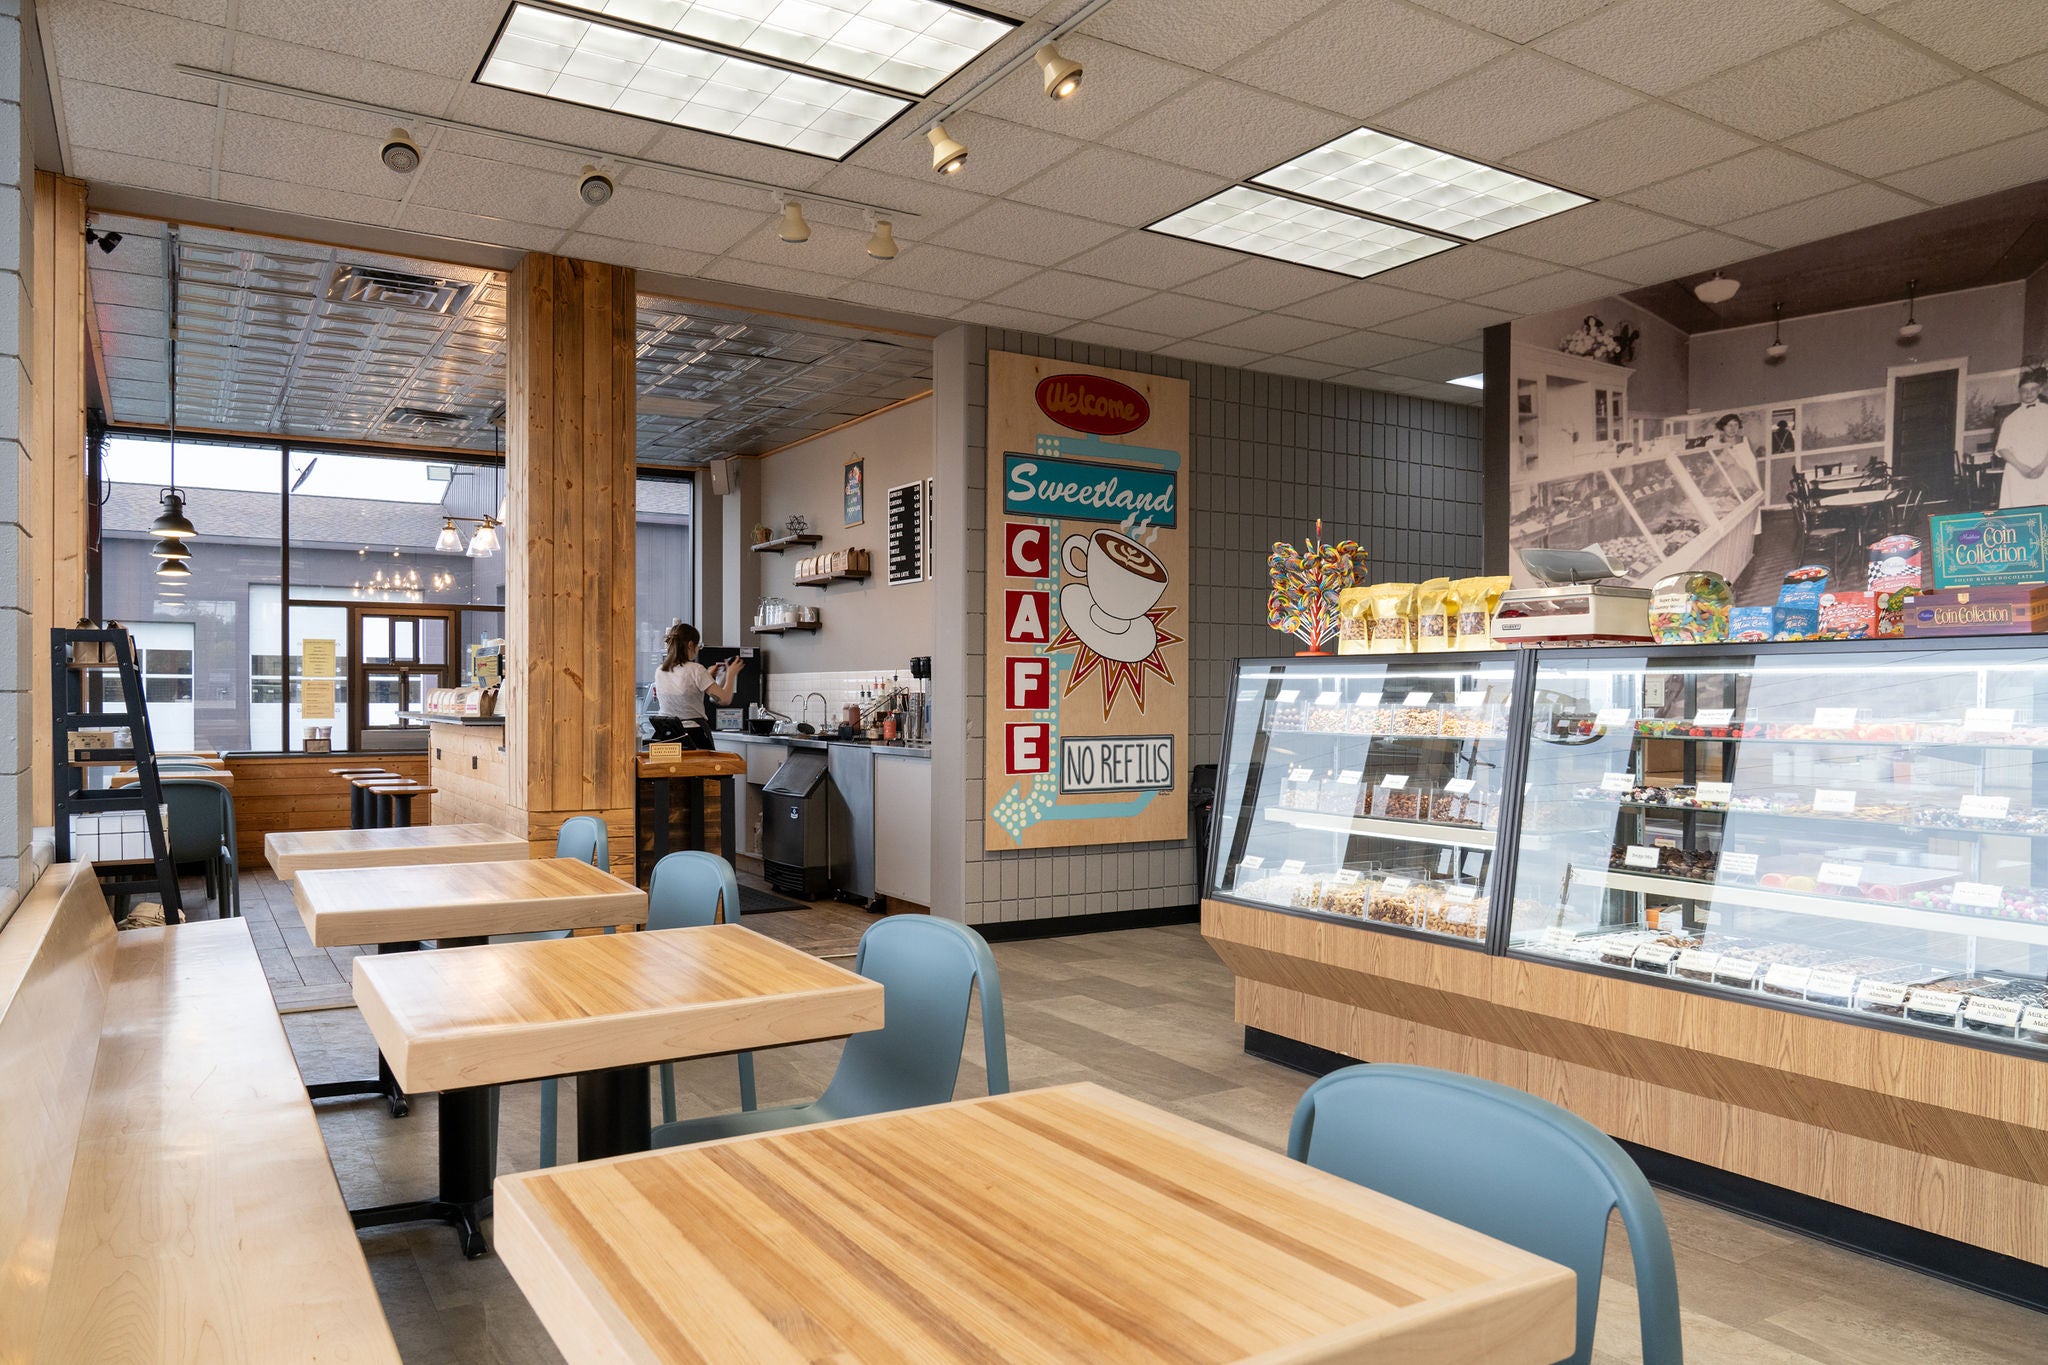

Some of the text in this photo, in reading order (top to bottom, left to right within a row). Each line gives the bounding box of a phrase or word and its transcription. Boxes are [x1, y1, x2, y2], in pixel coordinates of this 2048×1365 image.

[1046, 383, 1140, 421] Welcome
[1007, 462, 1174, 513] Sweetland
[1984, 526, 2016, 548] Coin
[1956, 544, 2027, 565] Collection
[1934, 605, 2008, 625] Coin Collection
[1067, 743, 1170, 785] NO REFILLS
[1971, 1000, 2018, 1013] Dark Chocolate
[2028, 1010, 2042, 1019] Milk
